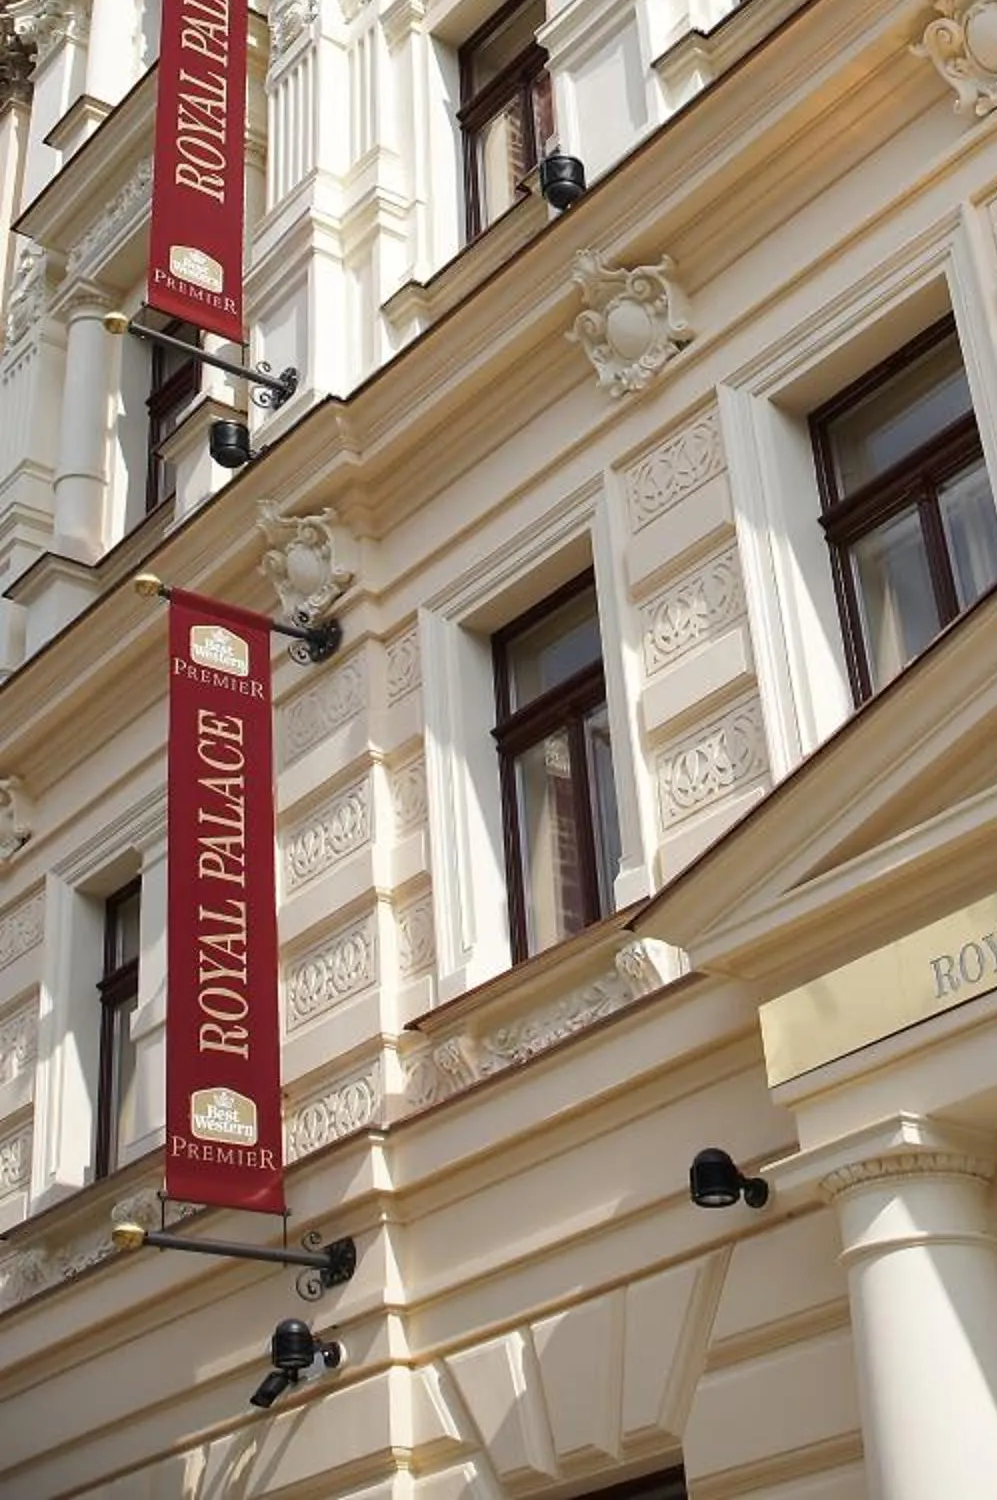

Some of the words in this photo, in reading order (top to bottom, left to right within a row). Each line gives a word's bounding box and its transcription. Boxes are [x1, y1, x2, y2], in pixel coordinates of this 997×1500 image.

[175, 68, 229, 205] ROYAL
[154, 266, 237, 315] PREMIER
[174, 656, 265, 700] PREMIER
[197, 709, 245, 888] PALACE
[197, 898, 249, 1061] ROYAL
[170, 1135, 277, 1171] PREMIER
